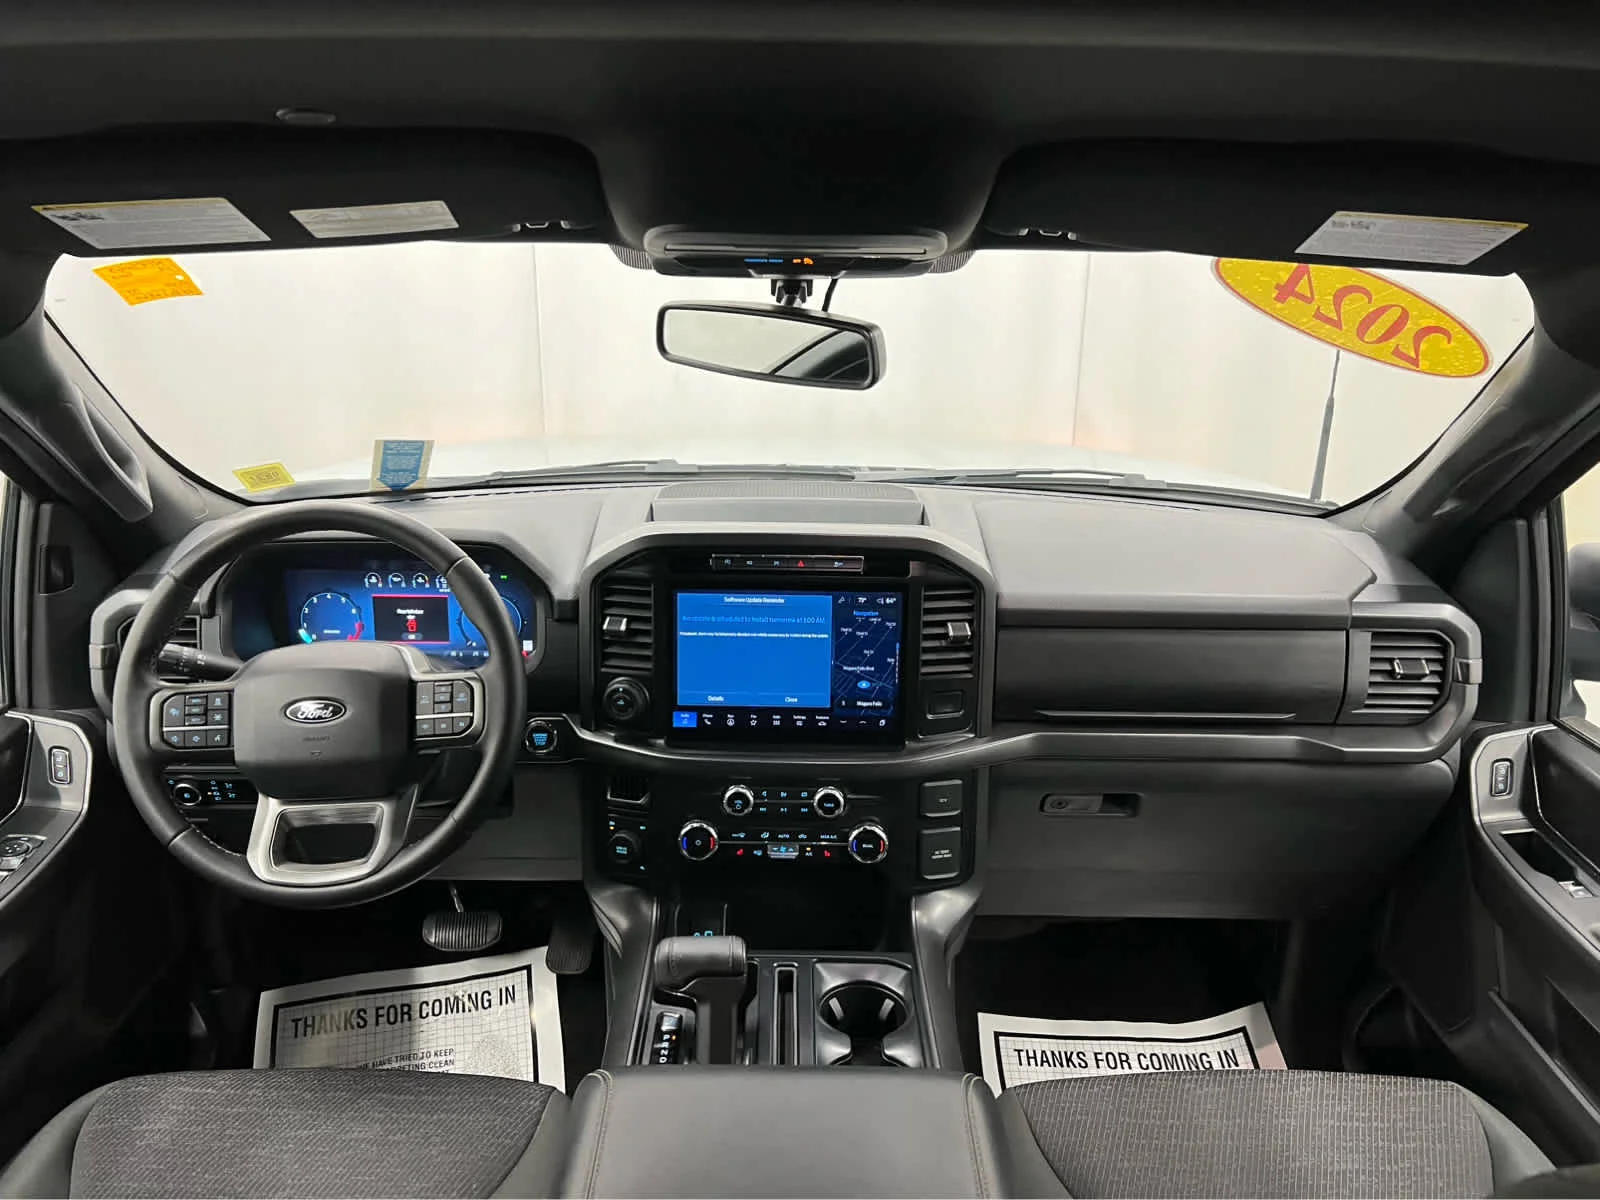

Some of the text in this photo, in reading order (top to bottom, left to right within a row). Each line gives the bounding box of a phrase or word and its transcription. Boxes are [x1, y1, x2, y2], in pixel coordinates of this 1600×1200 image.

[297, 703, 333, 718] Ford
[291, 984, 516, 1038] THANKS FOR COMING IN
[395, 1052, 418, 1063] TRIED
[433, 1048, 455, 1057] KEEP
[1014, 1048, 1240, 1071] THANKS FOR COMING IN
[428, 1059, 455, 1069] CLEAN
